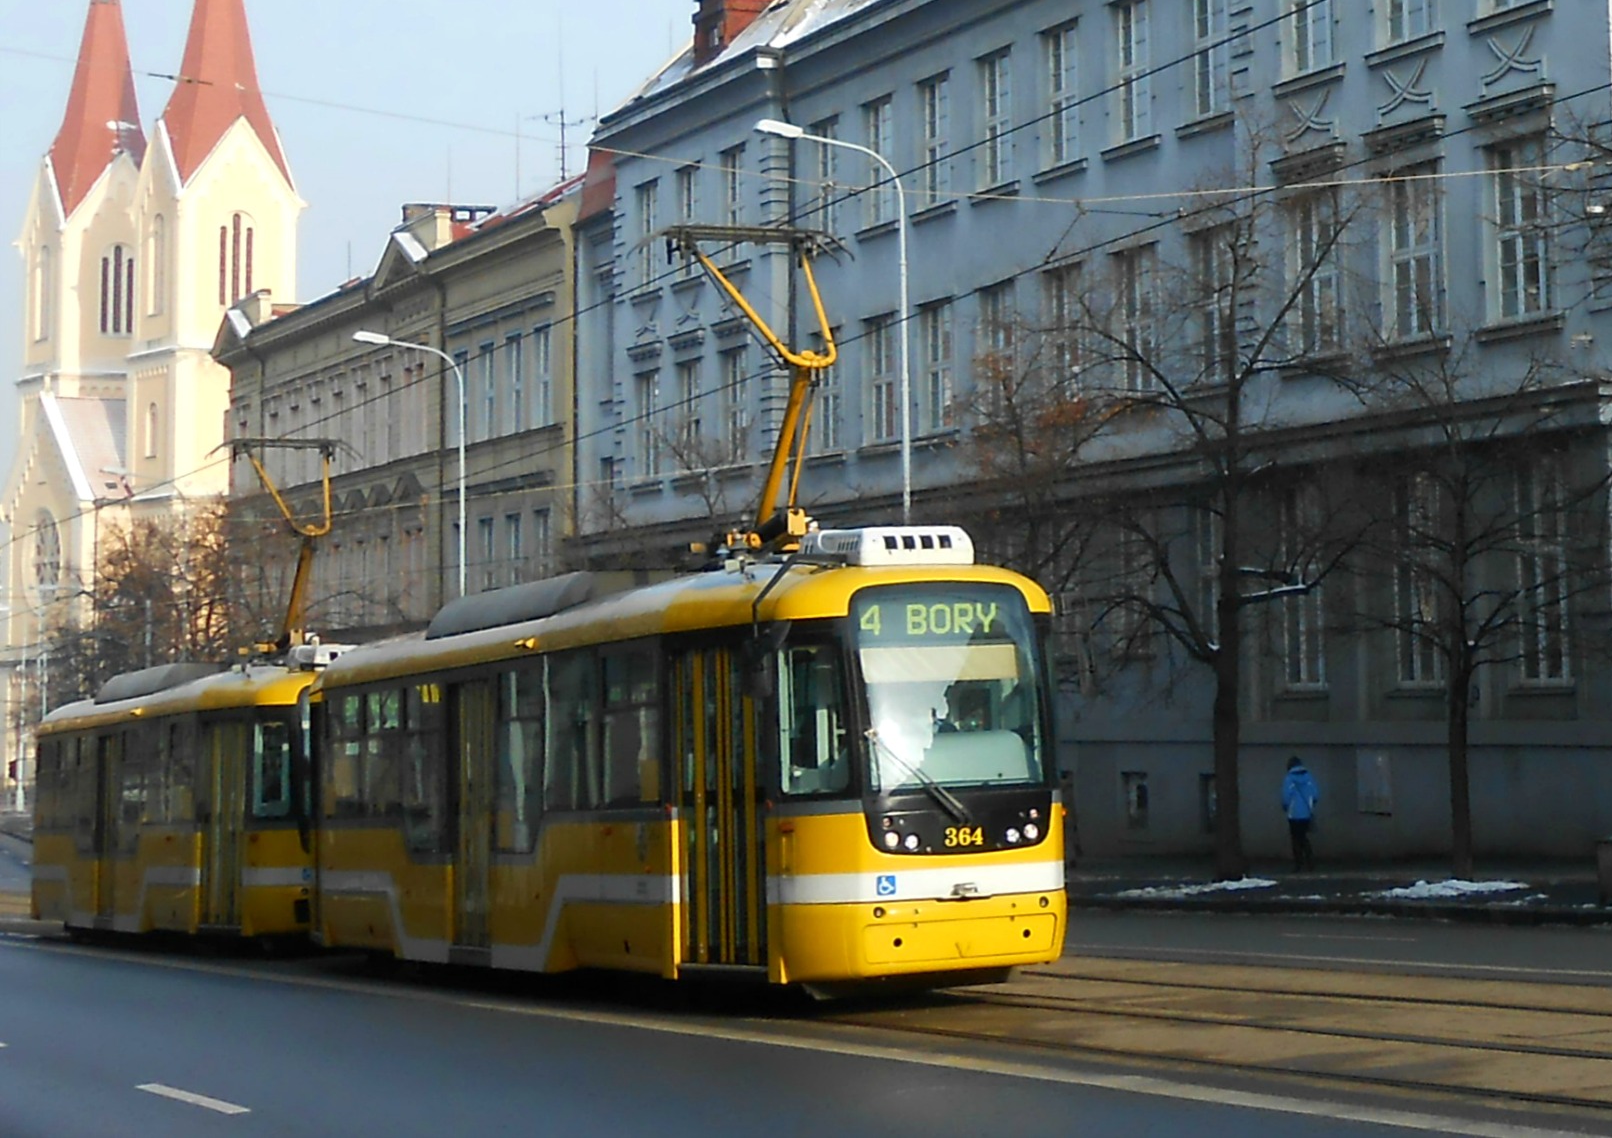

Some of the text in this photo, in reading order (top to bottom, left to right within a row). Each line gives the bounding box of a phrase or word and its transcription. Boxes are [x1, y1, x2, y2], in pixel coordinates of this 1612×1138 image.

[860, 602, 997, 636] 4 BORY
[944, 826, 984, 847] 364
